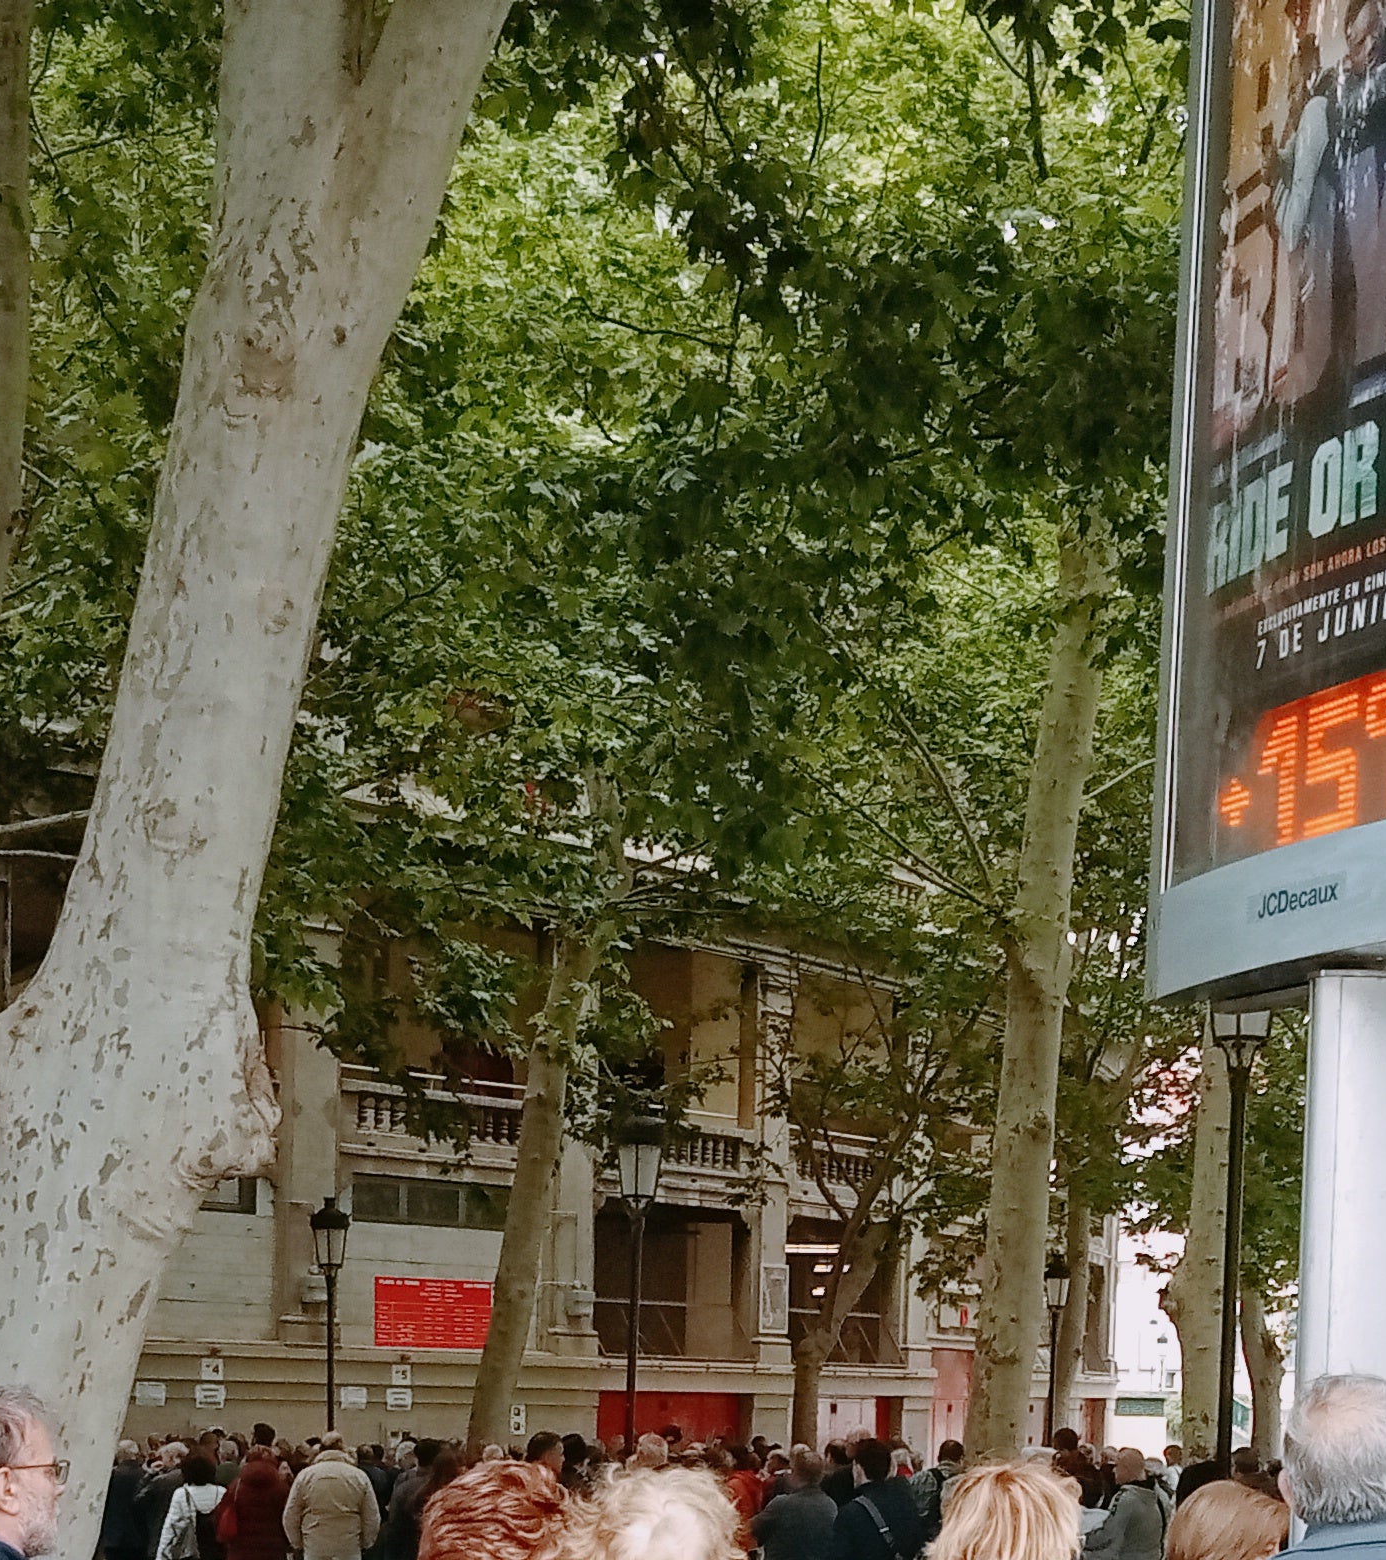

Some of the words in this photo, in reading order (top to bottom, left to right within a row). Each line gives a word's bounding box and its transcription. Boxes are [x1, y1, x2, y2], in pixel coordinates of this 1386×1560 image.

[1205, 460, 1293, 596] RIDE
[1307, 418, 1380, 539] OR
[1327, 548, 1362, 572] AHORA
[1366, 536, 1386, 558] LOS
[1257, 590, 1341, 636] EXCLUSIVAMENTE
[1344, 583, 1360, 600] EN
[1255, 639, 1268, 671] 7
[1278, 622, 1303, 660] DE
[1257, 882, 1339, 919] JCDecaux
